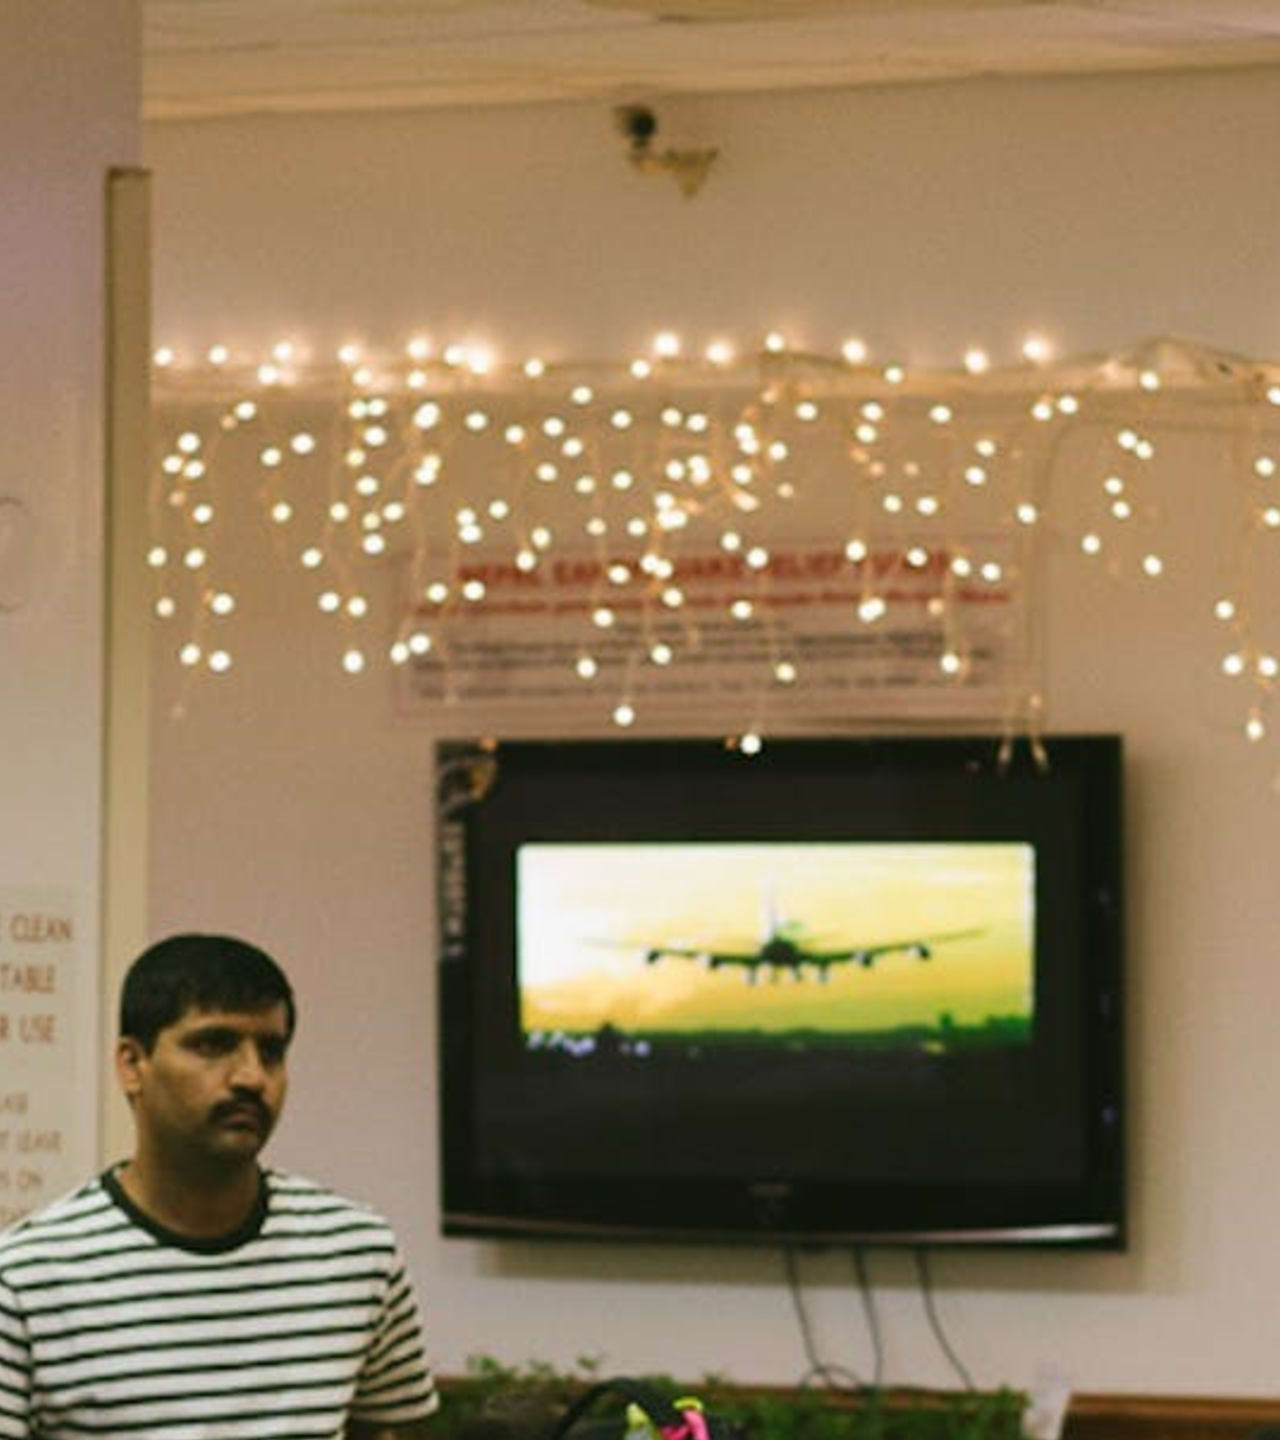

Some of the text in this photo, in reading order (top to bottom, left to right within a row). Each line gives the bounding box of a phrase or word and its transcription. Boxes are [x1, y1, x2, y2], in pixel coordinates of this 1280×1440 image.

[10, 913, 73, 943] CLEAN
[0, 962, 55, 994] TABLE
[19, 1013, 55, 1044] USE
